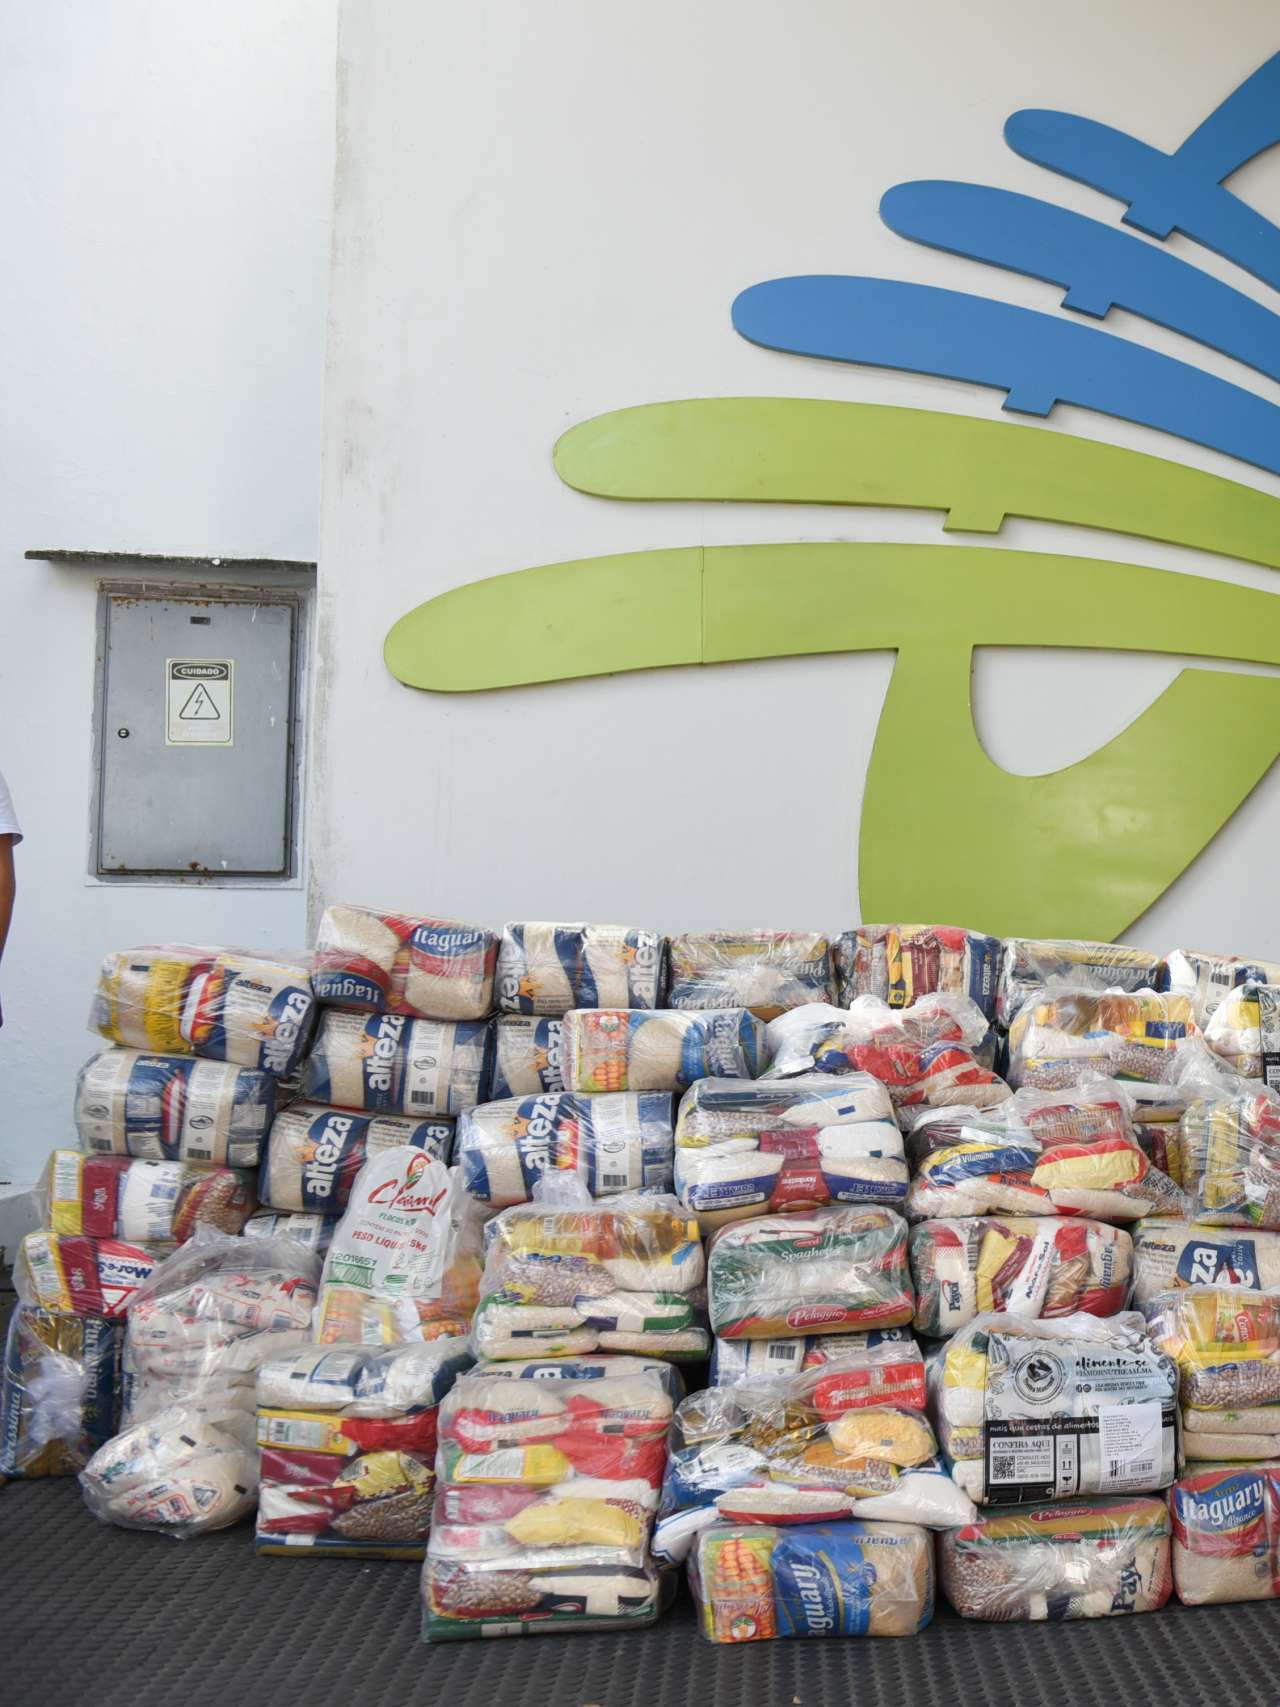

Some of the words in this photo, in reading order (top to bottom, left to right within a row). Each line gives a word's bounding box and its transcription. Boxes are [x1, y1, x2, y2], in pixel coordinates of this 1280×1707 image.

[180, 667, 220, 675] CUIDADO
[414, 926, 484, 951] Itaguar
[633, 930, 659, 1001] altez
[307, 1116, 353, 1198] alteza
[993, 1440, 1029, 1449] CONFIRA
[1030, 1439, 1051, 1449] AQUI
[1182, 1479, 1264, 1526] Itaguary
[790, 1562, 834, 1636] aguary
